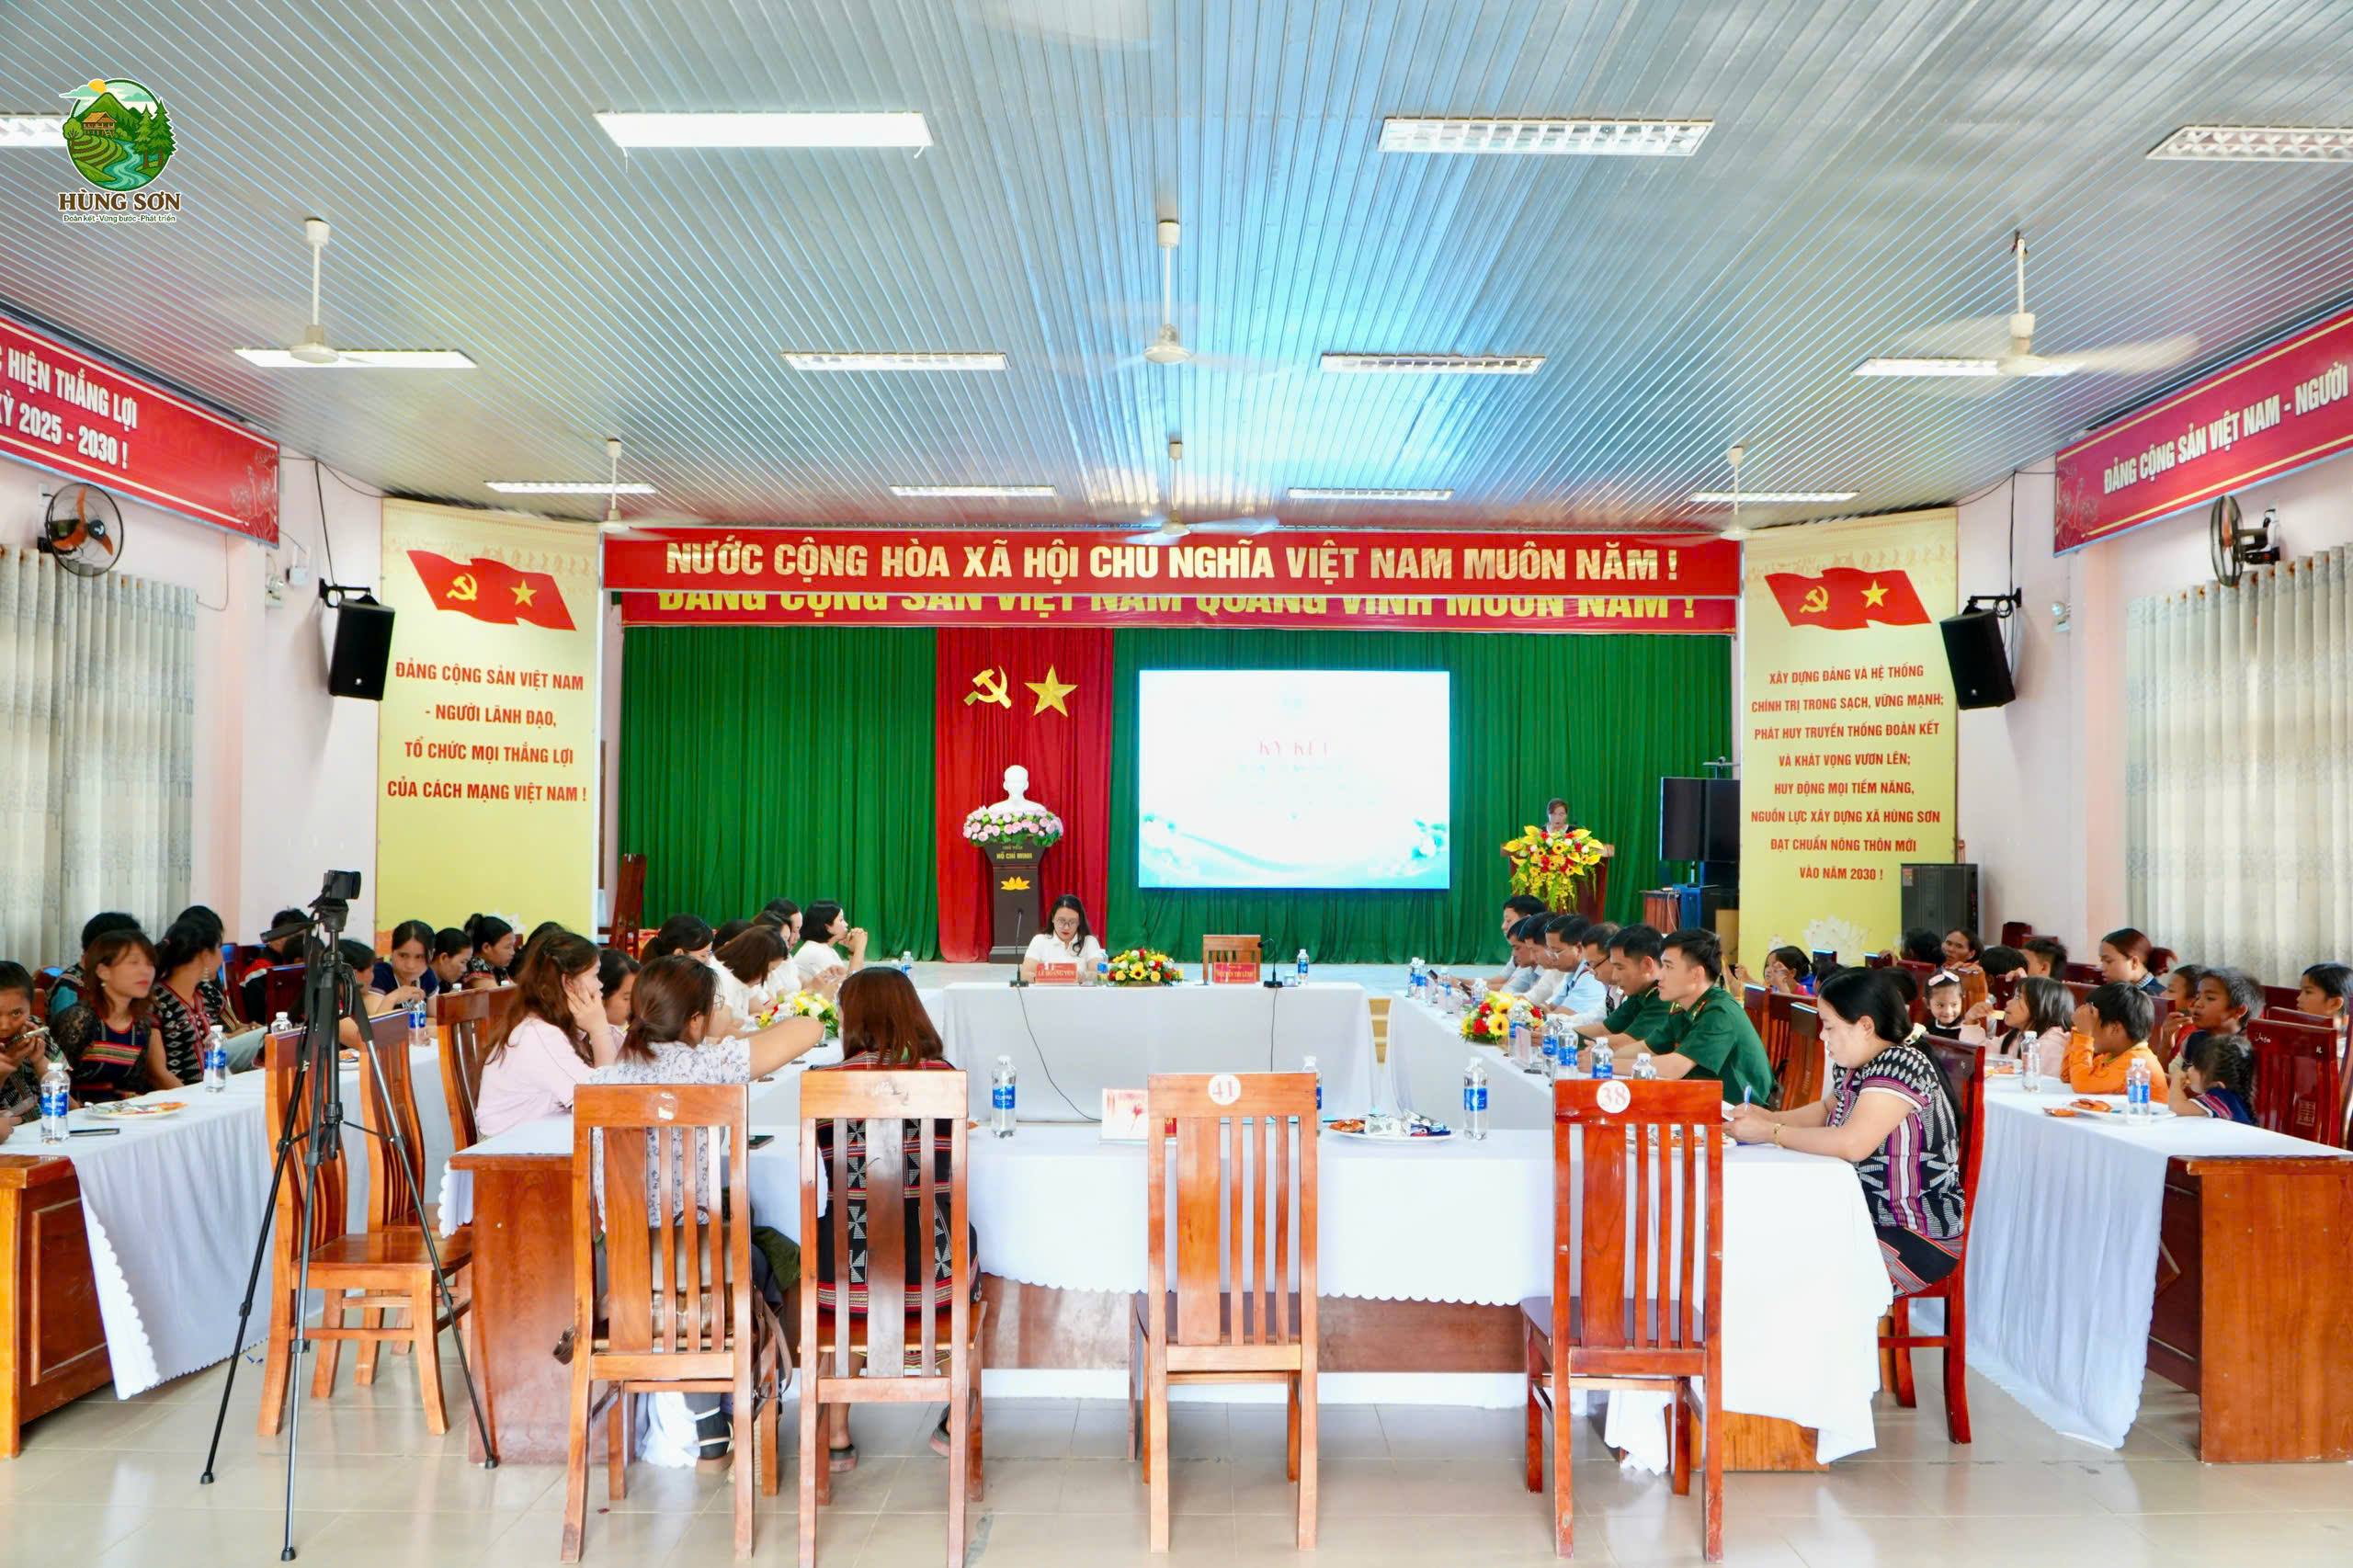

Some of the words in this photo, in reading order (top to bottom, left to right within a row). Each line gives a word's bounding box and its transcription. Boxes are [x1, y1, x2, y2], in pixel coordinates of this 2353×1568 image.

[8, 347, 50, 393] HIỆN
[55, 368, 109, 417] THẮNG
[113, 392, 138, 432] LỢI
[19, 403, 63, 444] 2025
[78, 426, 118, 465] 2030
[121, 441, 128, 470] !
[2104, 457, 2137, 494] ĐẢNG
[2140, 444, 2176, 481] CỘNG
[2177, 423, 2206, 463] SẢN
[2210, 411, 2240, 451] VIỆT
[2243, 394, 2279, 437] NAM
[2295, 361, 2348, 415] NGƯỜI
[666, 535, 764, 575] NƯỚC
[774, 537, 868, 583] CỘNG
[881, 539, 950, 577] HÒA
[963, 539, 1012, 577] XÃ
[1024, 539, 1078, 585] HỘI
[1169, 539, 1275, 578] NGHĨA
[1286, 539, 1359, 585] VIỆT
[1370, 548, 1452, 579] NAM
[1463, 541, 1565, 580] MUÔN
[1576, 541, 1657, 580] NĂM
[1668, 550, 1677, 581] !
[396, 658, 437, 680] ĐẢNG
[442, 664, 482, 685] CỘNG
[486, 665, 515, 685] SẢN
[520, 670, 548, 690] VIỆT
[552, 675, 584, 690] NAM
[1769, 670, 1789, 684] XÂY
[1791, 671, 1819, 686] DỰNG
[1823, 666, 1851, 681] ĐẢNG
[1855, 665, 1868, 680] VÀ
[1871, 665, 1884, 681] HỆ
[1888, 662, 1924, 677] THỐNG
[1751, 699, 1781, 712] CHÍNH
[1785, 699, 1800, 713] TRỊ
[1803, 698, 1836, 710] TRONG
[1840, 697, 1871, 711] SẠCH,
[1875, 693, 1904, 708] VỮNG
[436, 702, 480, 722] NGƯỜI
[485, 705, 521, 724] LÃNH
[526, 710, 556, 729] ĐẠO,
[1754, 726, 1779, 740] PHÁT
[1782, 727, 1802, 739] HUY
[1847, 722, 1882, 736] THỐNG
[1886, 722, 1915, 735] ĐOÀN
[1919, 719, 1939, 734] KẾT
[405, 736, 424, 757] TỔ
[428, 741, 466, 759] CHỨC
[472, 744, 498, 764] MỌI
[504, 742, 548, 763] THẮNG
[552, 748, 574, 767] LỢI
[1779, 753, 1791, 767] VÀ
[1794, 753, 1820, 767] KHÁT
[1824, 754, 1851, 768] VỌNG
[1855, 753, 1883, 765] VƯƠN
[387, 776, 417, 797] CỦA
[423, 779, 460, 798] CÁCH
[467, 783, 509, 802] MẠNG
[514, 782, 542, 803] VIỆT
[547, 787, 577, 801] NAM
[1774, 783, 1794, 794] HUY
[1797, 781, 1824, 797] ĐỘNG
[1828, 782, 1848, 797] MỌI
[1789, 810, 1807, 824] LỰC
[1811, 809, 1830, 822] XÂY
[1834, 810, 1862, 824] DỰNG
[1866, 809, 1880, 823] XÃ
[1883, 809, 1914, 823] HÙNG
[1917, 810, 1940, 823] SƠN
[1770, 838, 1790, 853] ĐẠT
[1831, 837, 1860, 851] NÔNG
[1864, 836, 1892, 851] THÔN
[1895, 837, 1916, 852] MỚI
[1800, 864, 1820, 879] VÀO
[1823, 865, 1847, 879] NĂM
[1850, 869, 1876, 880] 2030
[1601, 1087, 1626, 1105] 38
